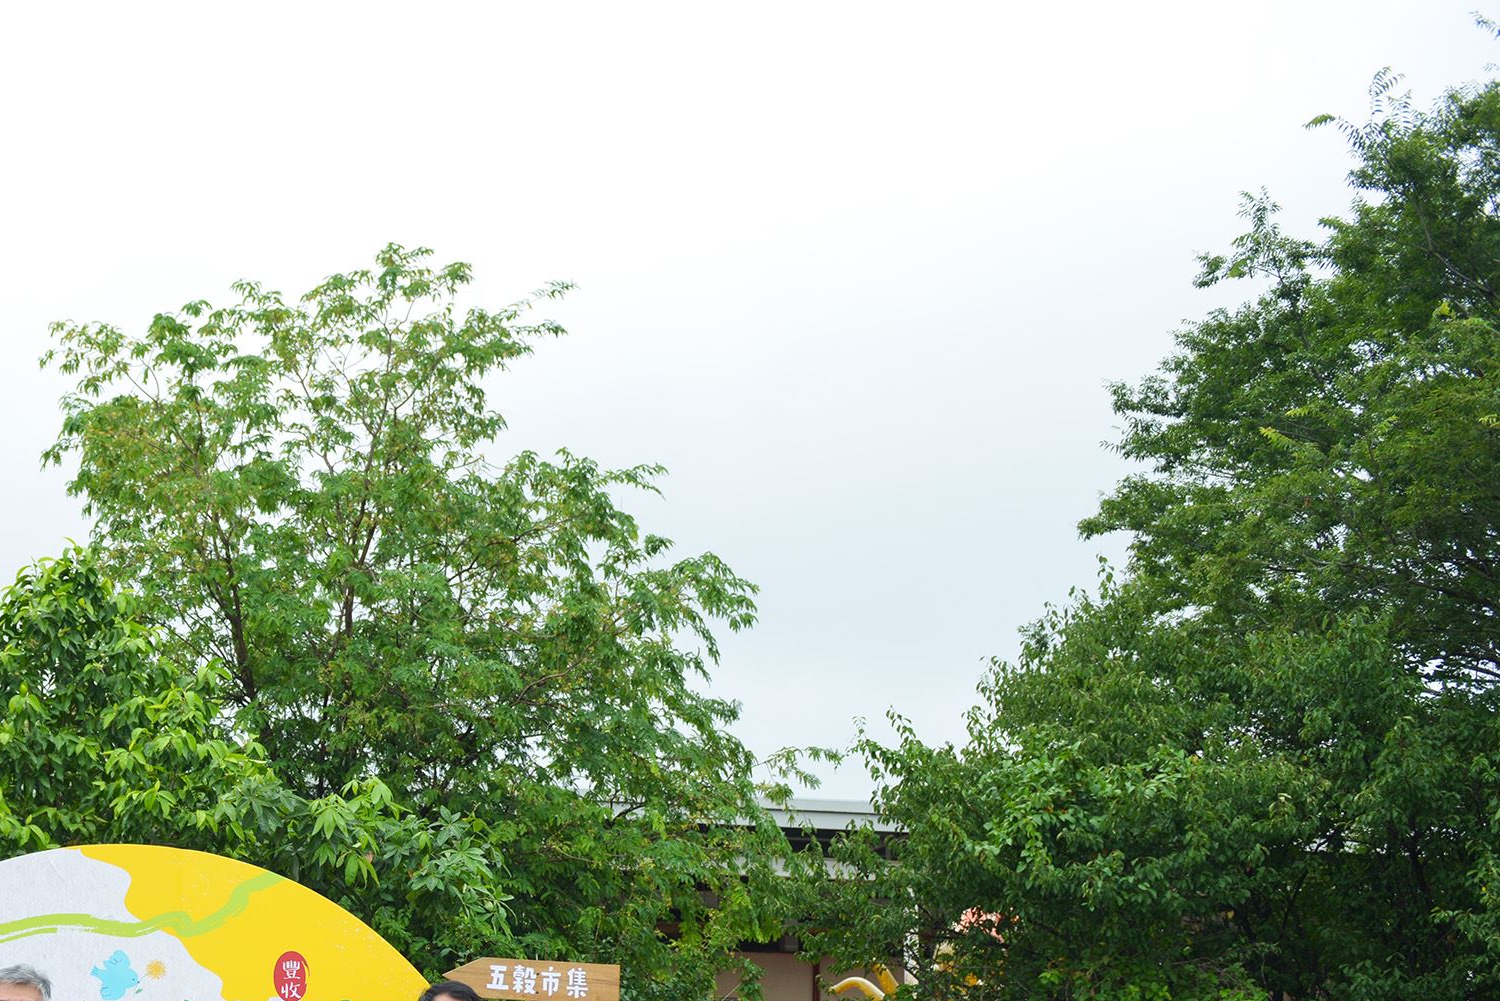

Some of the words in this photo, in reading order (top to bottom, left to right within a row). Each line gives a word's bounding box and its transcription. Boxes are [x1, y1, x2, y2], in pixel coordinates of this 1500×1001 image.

[281, 959, 301, 999] 豐收
[486, 964, 588, 998] 五穀市集
